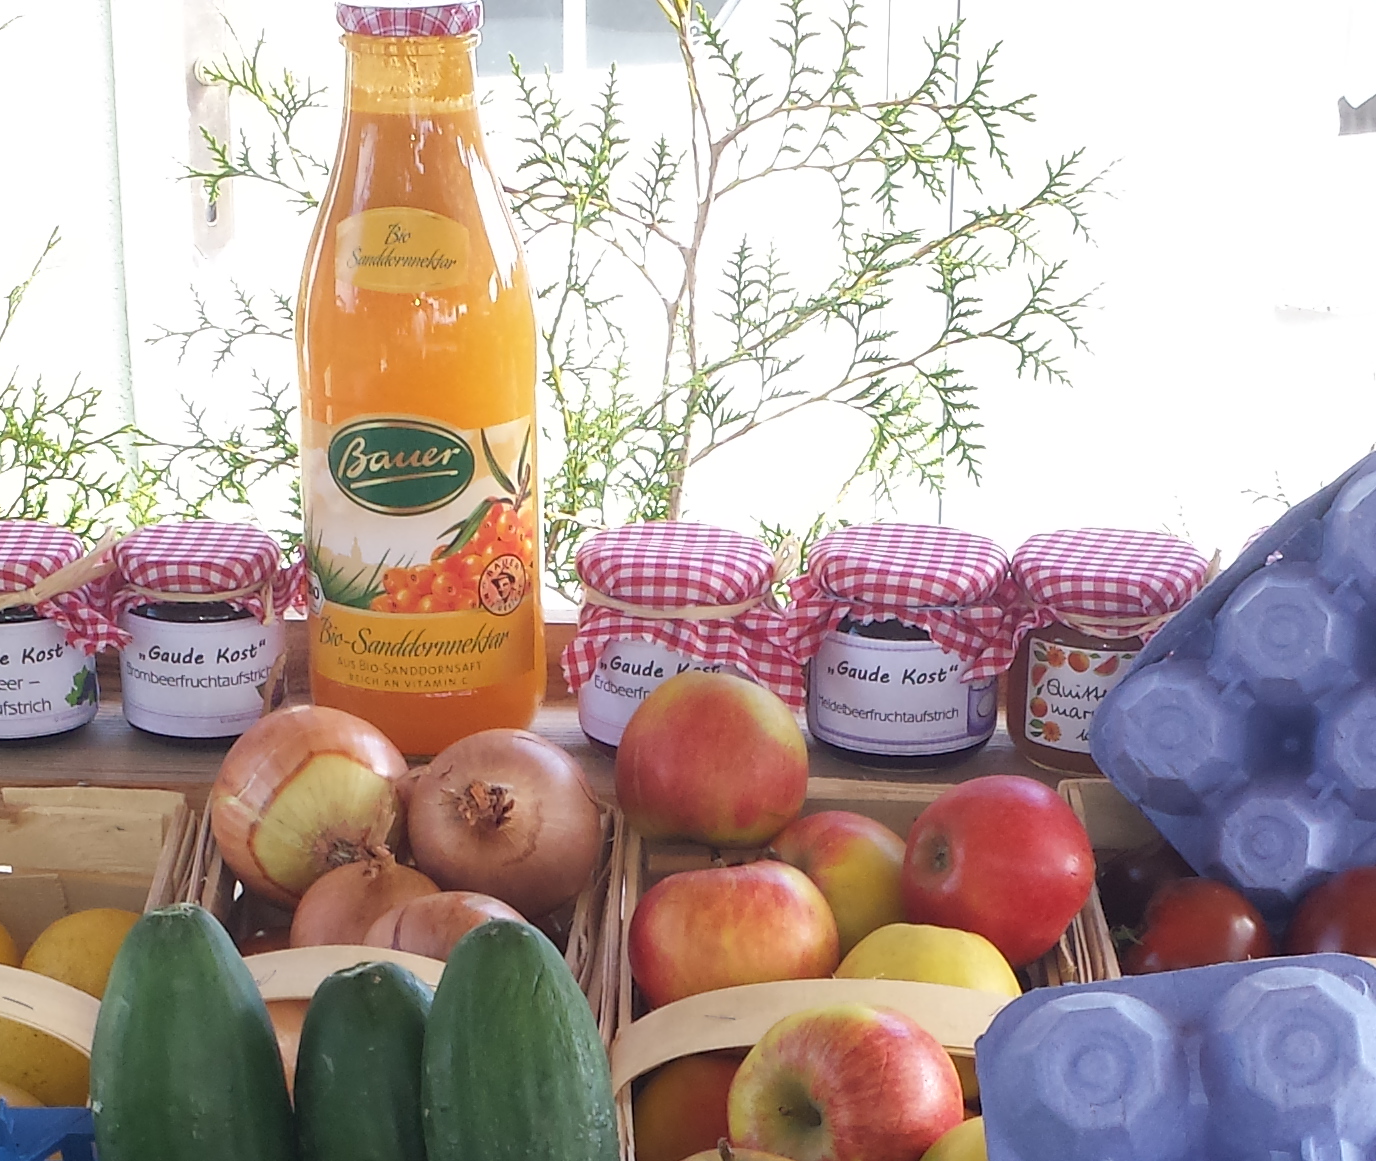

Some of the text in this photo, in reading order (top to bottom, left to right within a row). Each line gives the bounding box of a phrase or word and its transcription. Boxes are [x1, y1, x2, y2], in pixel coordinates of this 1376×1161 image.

[385, 222, 411, 245] Bio
[347, 245, 457, 271] Sanddornnektar
[337, 436, 461, 479] Bauer
[320, 616, 509, 657] Bio-Sanddornnektar
[405, 678, 456, 688] VITAMIN
[594, 675, 650, 700] Erdbeerfr
